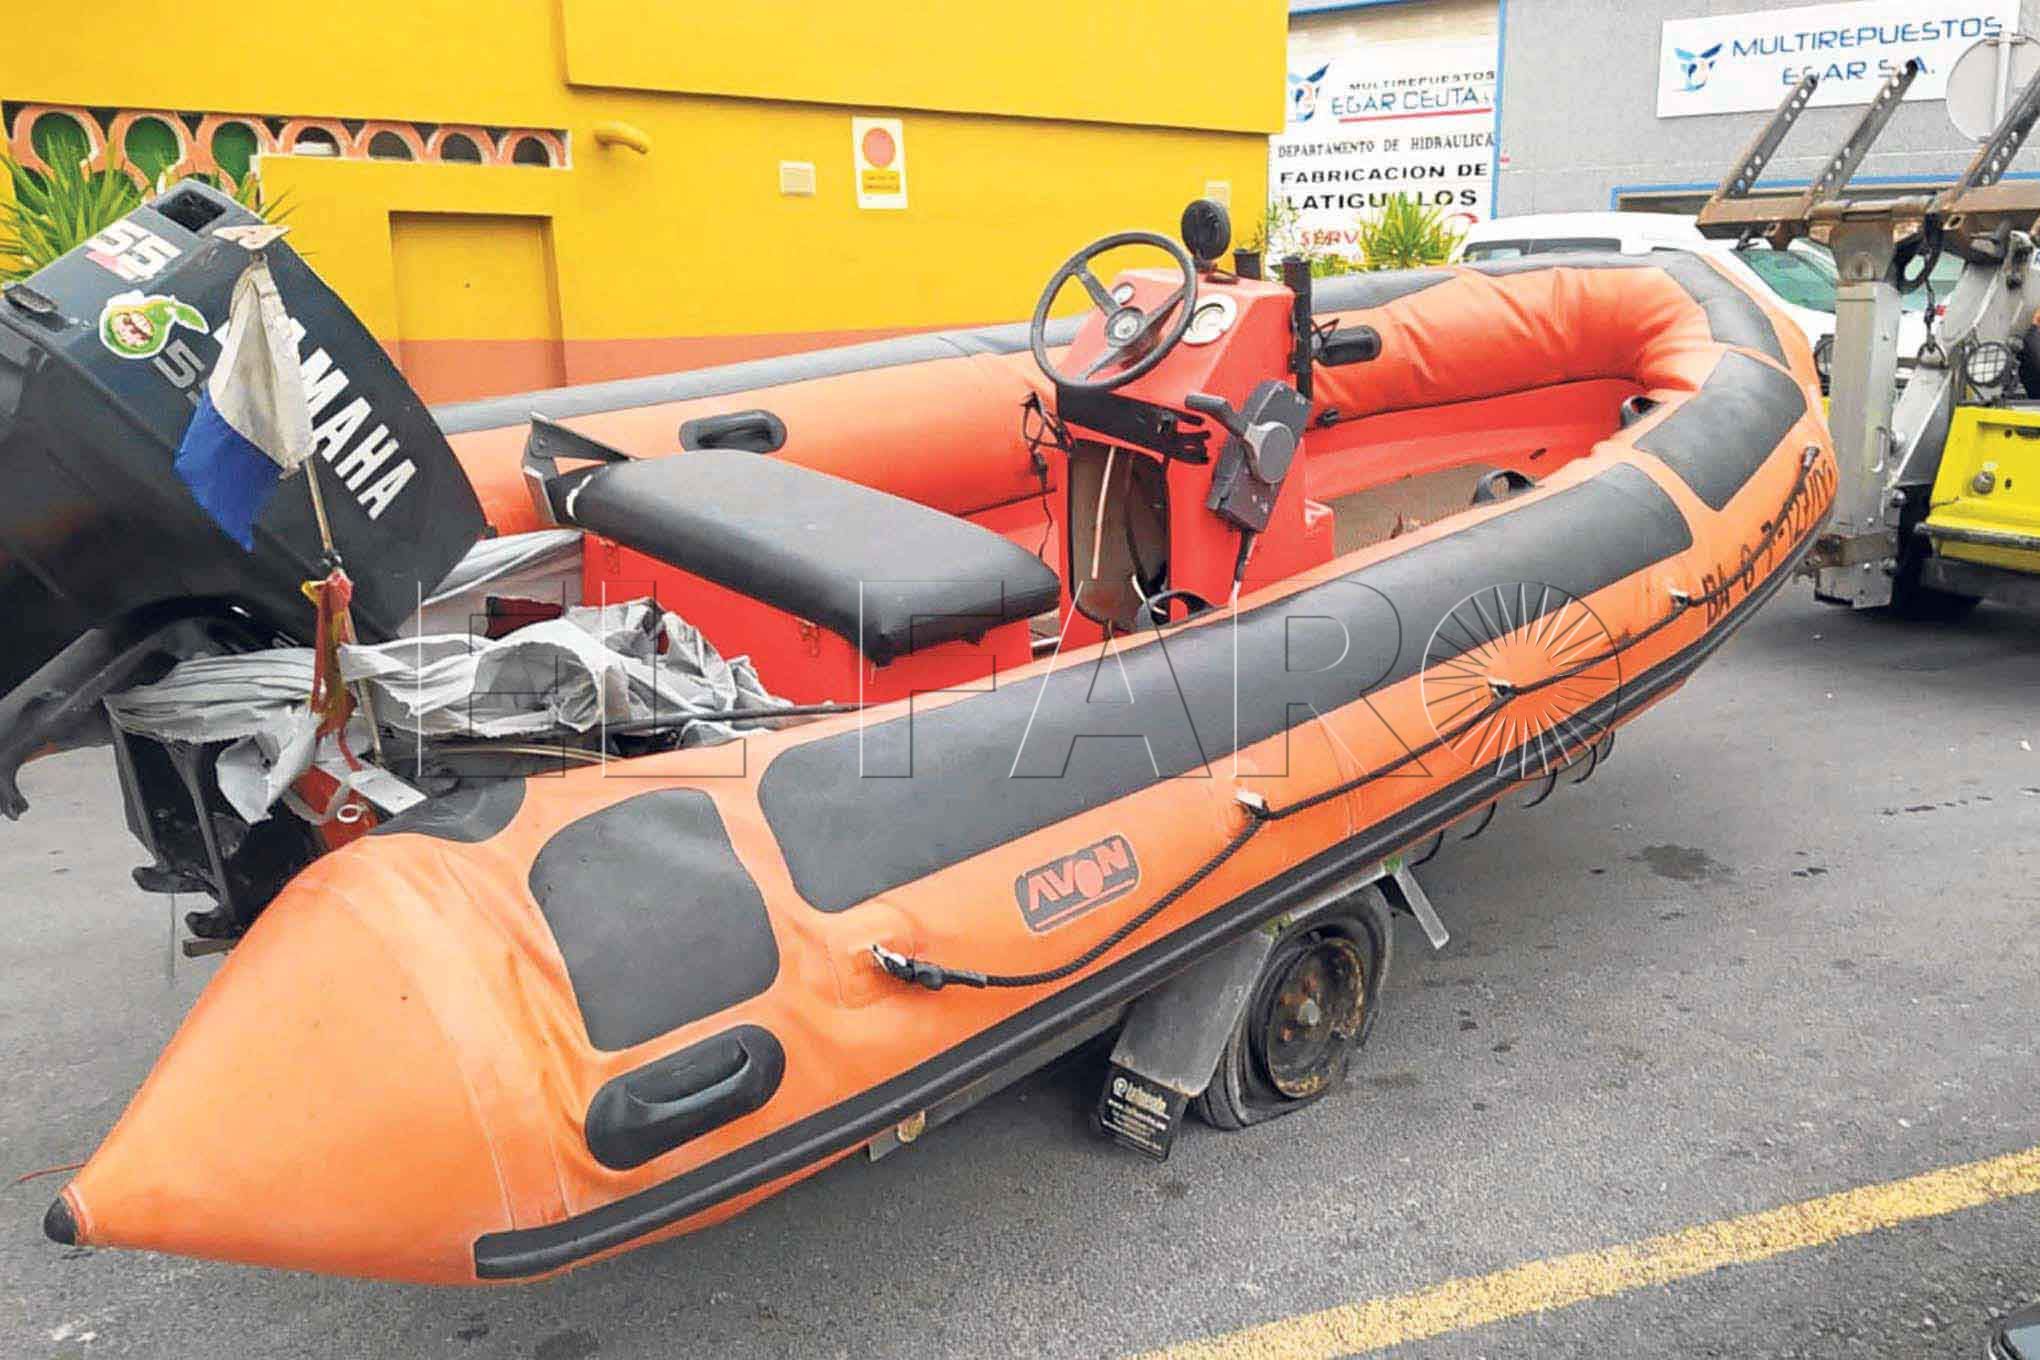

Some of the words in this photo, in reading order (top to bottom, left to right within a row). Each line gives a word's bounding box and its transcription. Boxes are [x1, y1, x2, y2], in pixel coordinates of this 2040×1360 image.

[1732, 16, 2002, 57] MULTIREPUESTOS
[1331, 92, 1396, 116] EGAR
[1403, 86, 1478, 110] CEUTA
[1278, 139, 1375, 158] DEPARTAMENTO
[1384, 138, 1400, 152] DE
[1280, 165, 1445, 184] FABRICACION
[1458, 163, 1488, 176] DE
[1028, 840, 1130, 911] AVON
